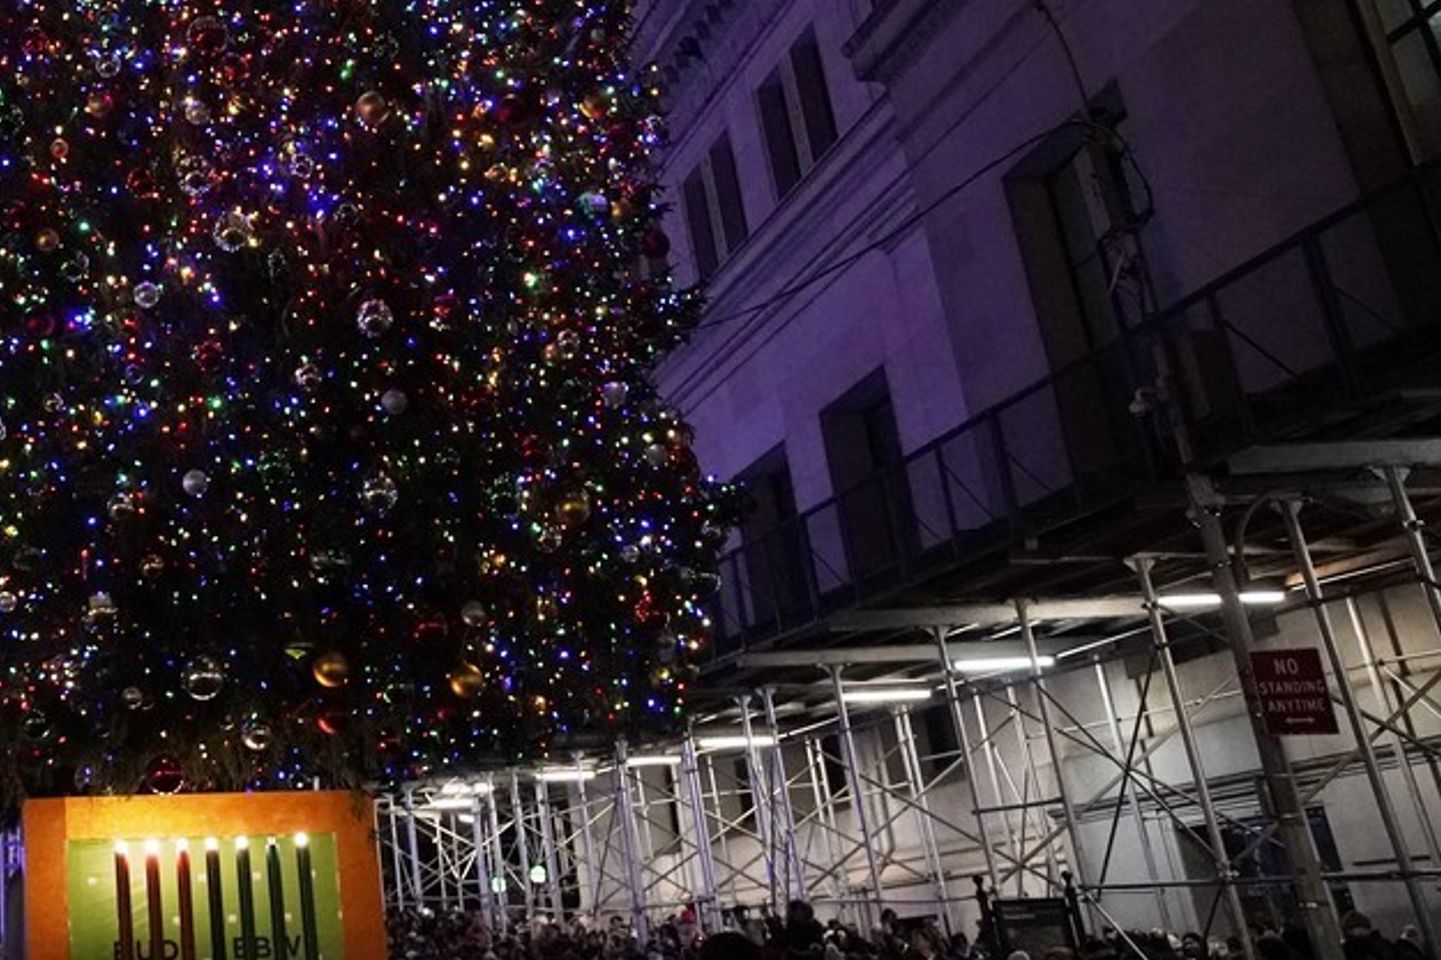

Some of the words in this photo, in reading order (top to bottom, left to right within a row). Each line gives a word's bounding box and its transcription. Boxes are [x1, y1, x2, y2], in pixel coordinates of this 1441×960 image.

[1273, 657, 1300, 675] NO
[1259, 679, 1326, 697] STANDING
[1268, 698, 1326, 713] ANYTIME
